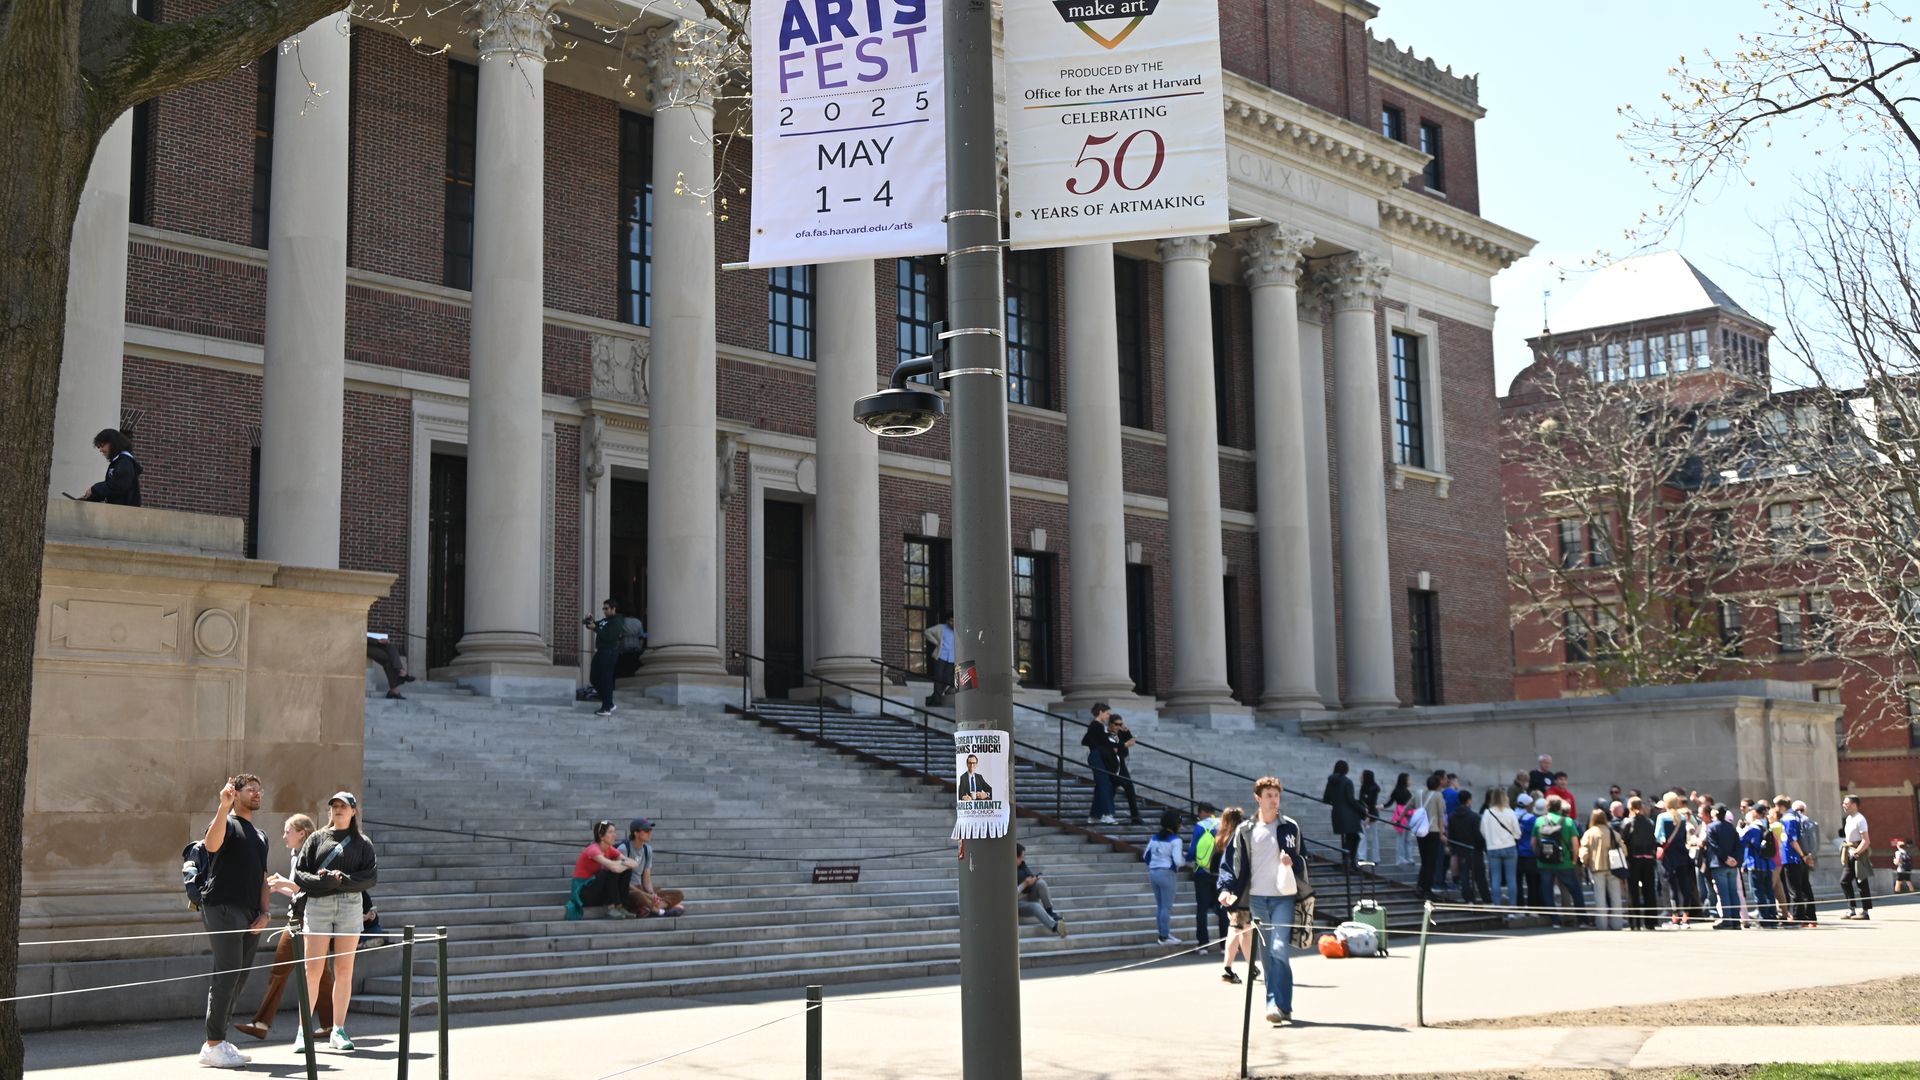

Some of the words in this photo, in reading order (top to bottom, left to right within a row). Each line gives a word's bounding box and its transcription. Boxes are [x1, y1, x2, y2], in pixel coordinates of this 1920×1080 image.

[1068, 0, 1115, 18] make
[1120, 0, 1149, 13] art.
[779, 25, 927, 94] FEST
[1060, 65, 1122, 79] PRODUCED
[1125, 63, 1139, 74] BY
[1141, 61, 1164, 73] THE
[1024, 87, 1061, 100] Office
[1065, 86, 1083, 97] for
[1086, 84, 1105, 96] the
[1108, 82, 1134, 94] Arts
[1137, 82, 1149, 92] at
[1152, 75, 1202, 90] Harvard
[1061, 105, 1168, 125] CELEBRATING
[818, 136, 895, 171] MAY
[1065, 129, 1166, 195] 50
[1228, 153, 1321, 201] CMXIV
[1031, 205, 1079, 221] YEARS
[1083, 203, 1104, 216] OF
[1109, 195, 1206, 214] ARTMAKING
[795, 221, 913, 240] ofa.fas.harvard.edu/arts
[972, 744, 1001, 753] CHUCK!
[975, 735, 1000, 744] YEARS!
[974, 801, 1002, 809] KRANTZ
